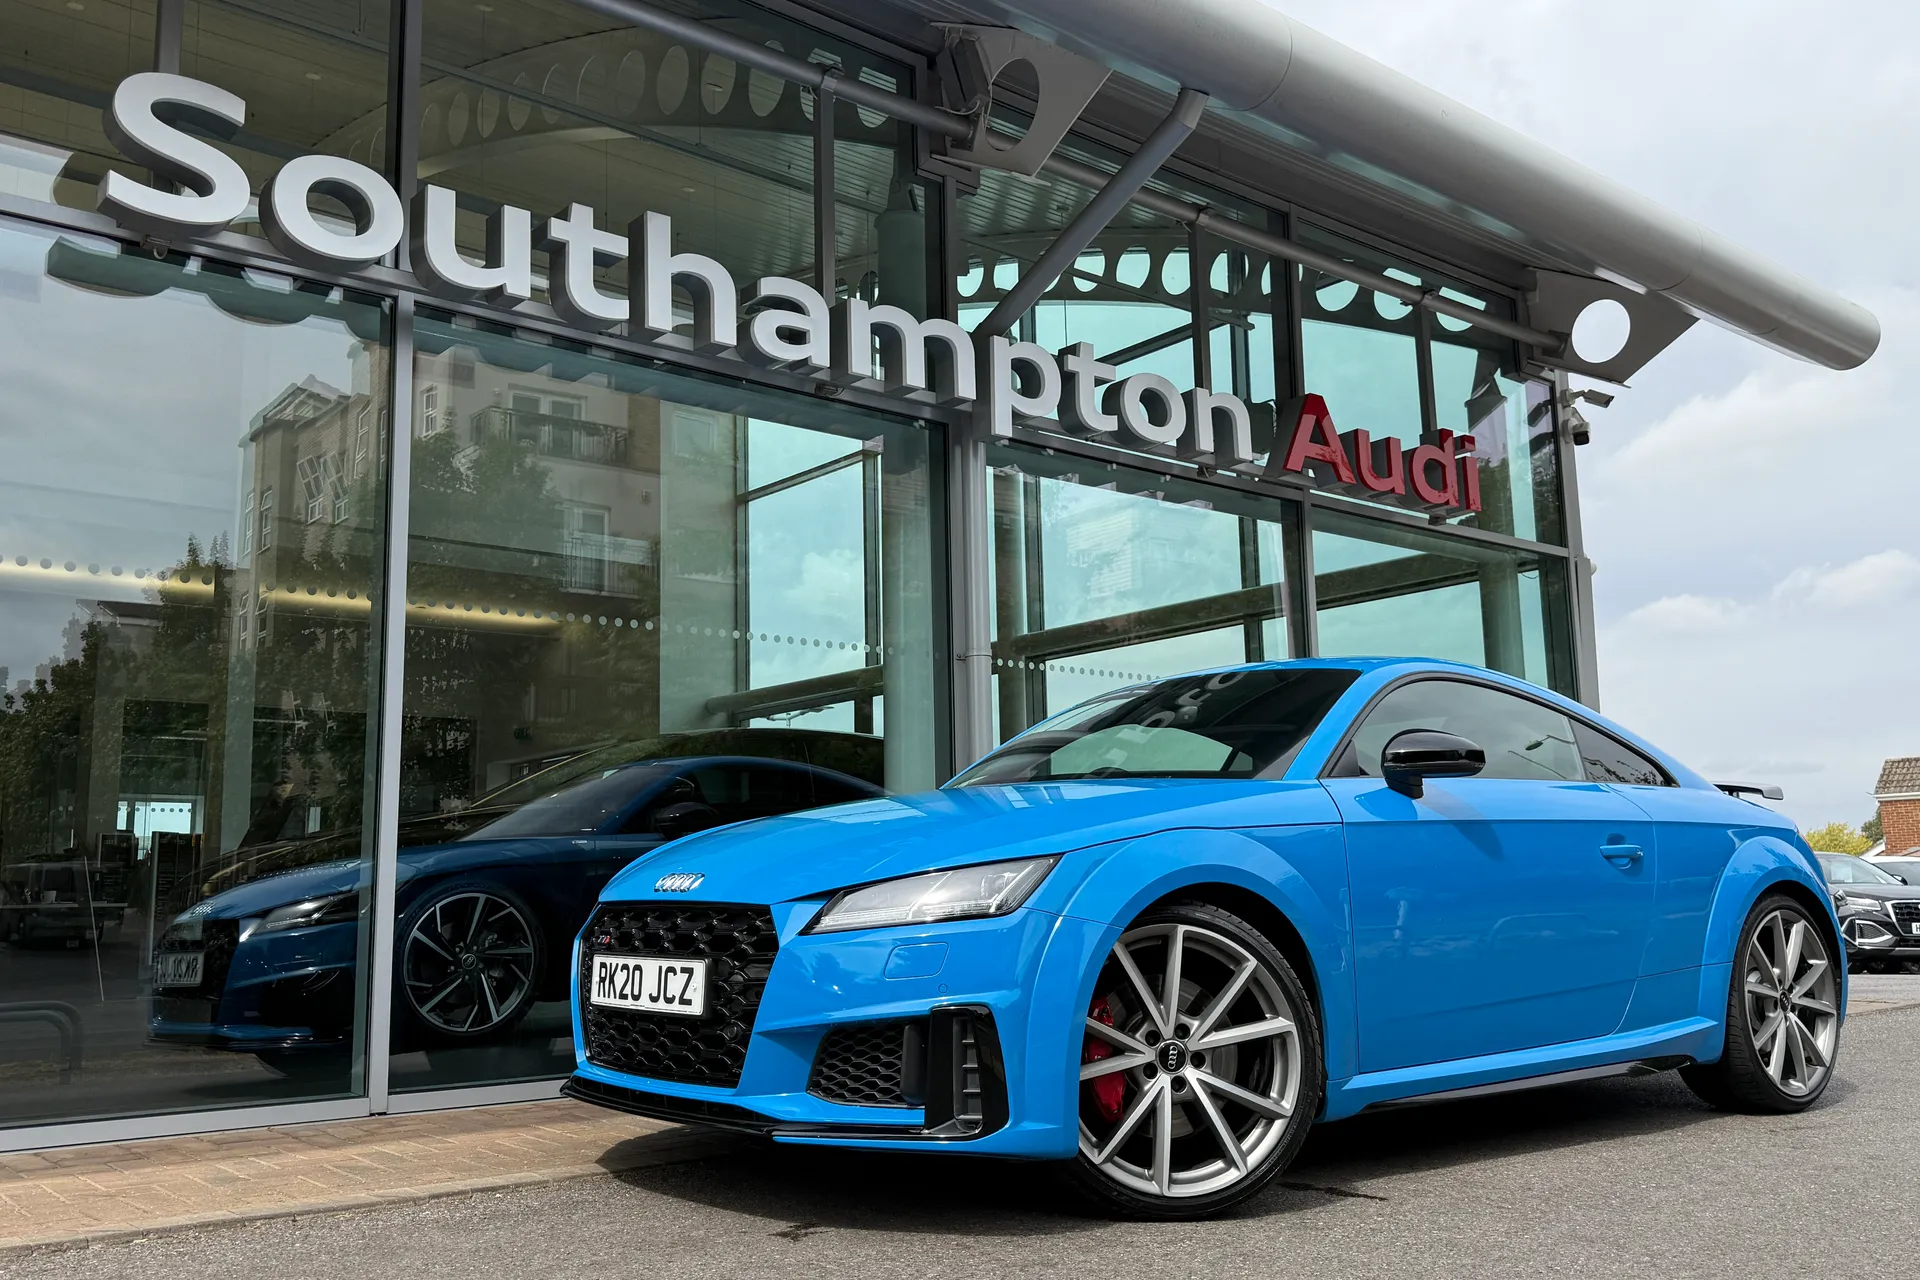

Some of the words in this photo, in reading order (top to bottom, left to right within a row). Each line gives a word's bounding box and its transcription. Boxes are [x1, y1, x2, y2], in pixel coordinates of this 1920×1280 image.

[103, 71, 1253, 463] Southampton
[1283, 392, 1482, 512] Audi
[597, 961, 644, 1002] RK20
[648, 965, 695, 1006] JCZ
